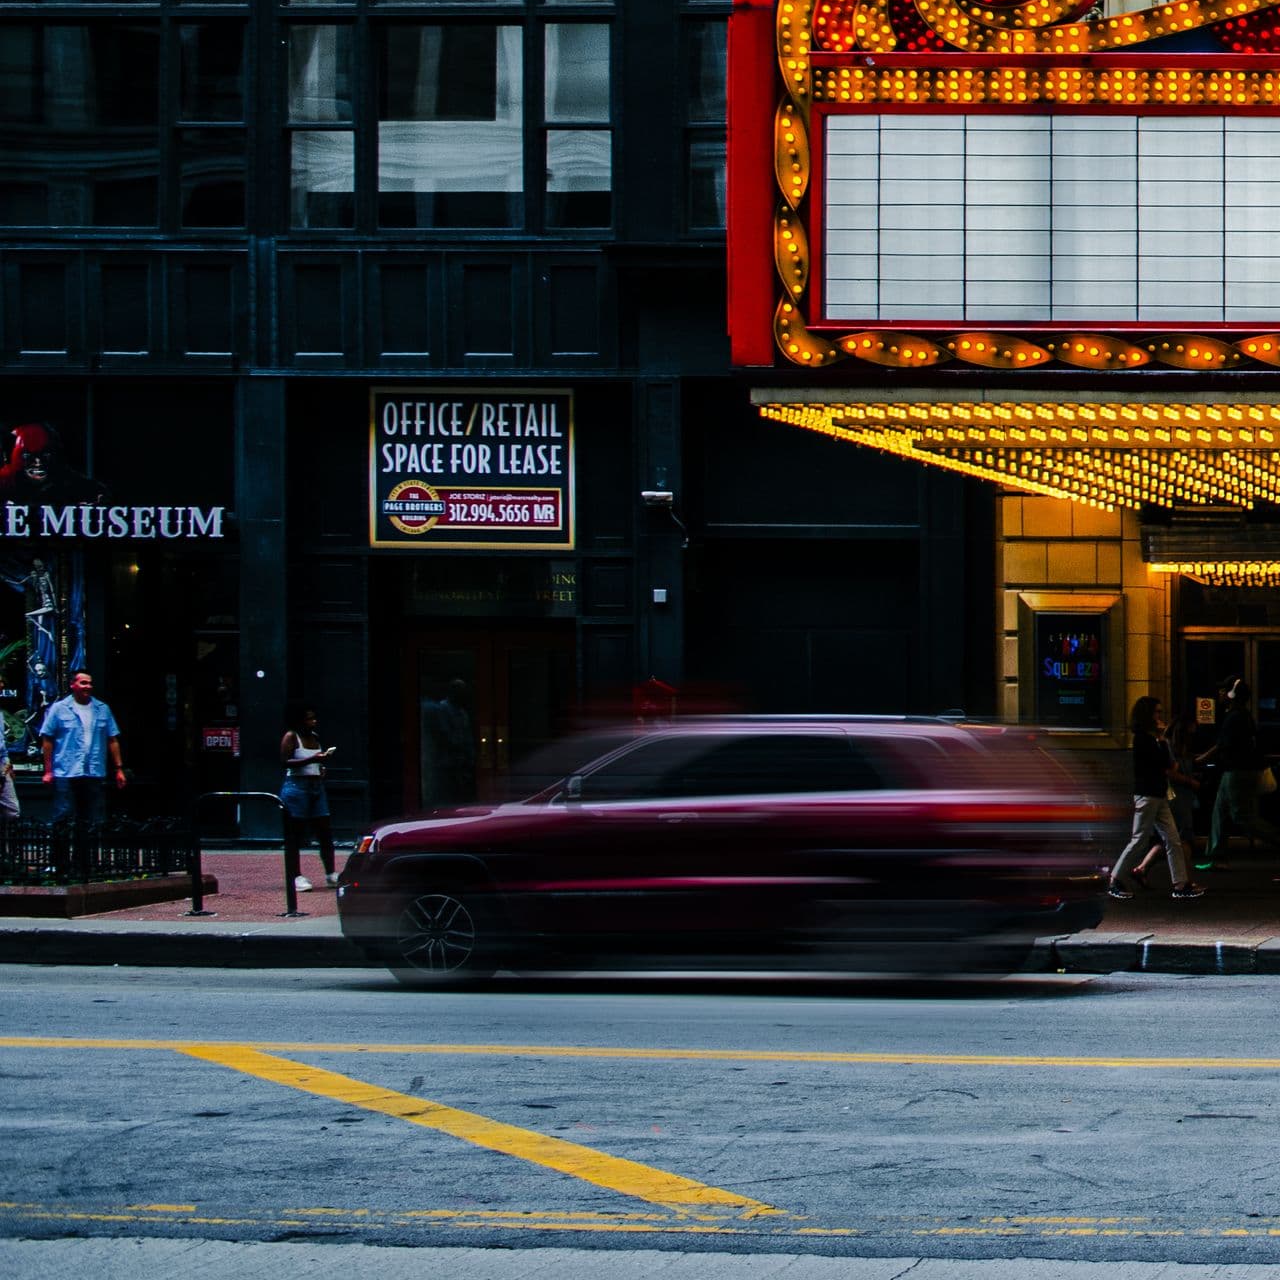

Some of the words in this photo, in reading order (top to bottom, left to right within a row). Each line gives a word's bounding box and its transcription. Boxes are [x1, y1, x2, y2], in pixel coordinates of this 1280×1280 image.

[383, 402, 563, 438] OFFICE/RETAIL
[382, 442, 444, 474] SPACE
[449, 443, 492, 474] FOR
[499, 444, 563, 475] LEASE
[384, 502, 404, 511] PAGE
[405, 502, 444, 512] BROTHERS
[448, 503, 530, 523] 312.994.5656
[0, 505, 30, 538] E
[41, 505, 225, 538] MUSEUM
[206, 736, 232, 748] OPEN
